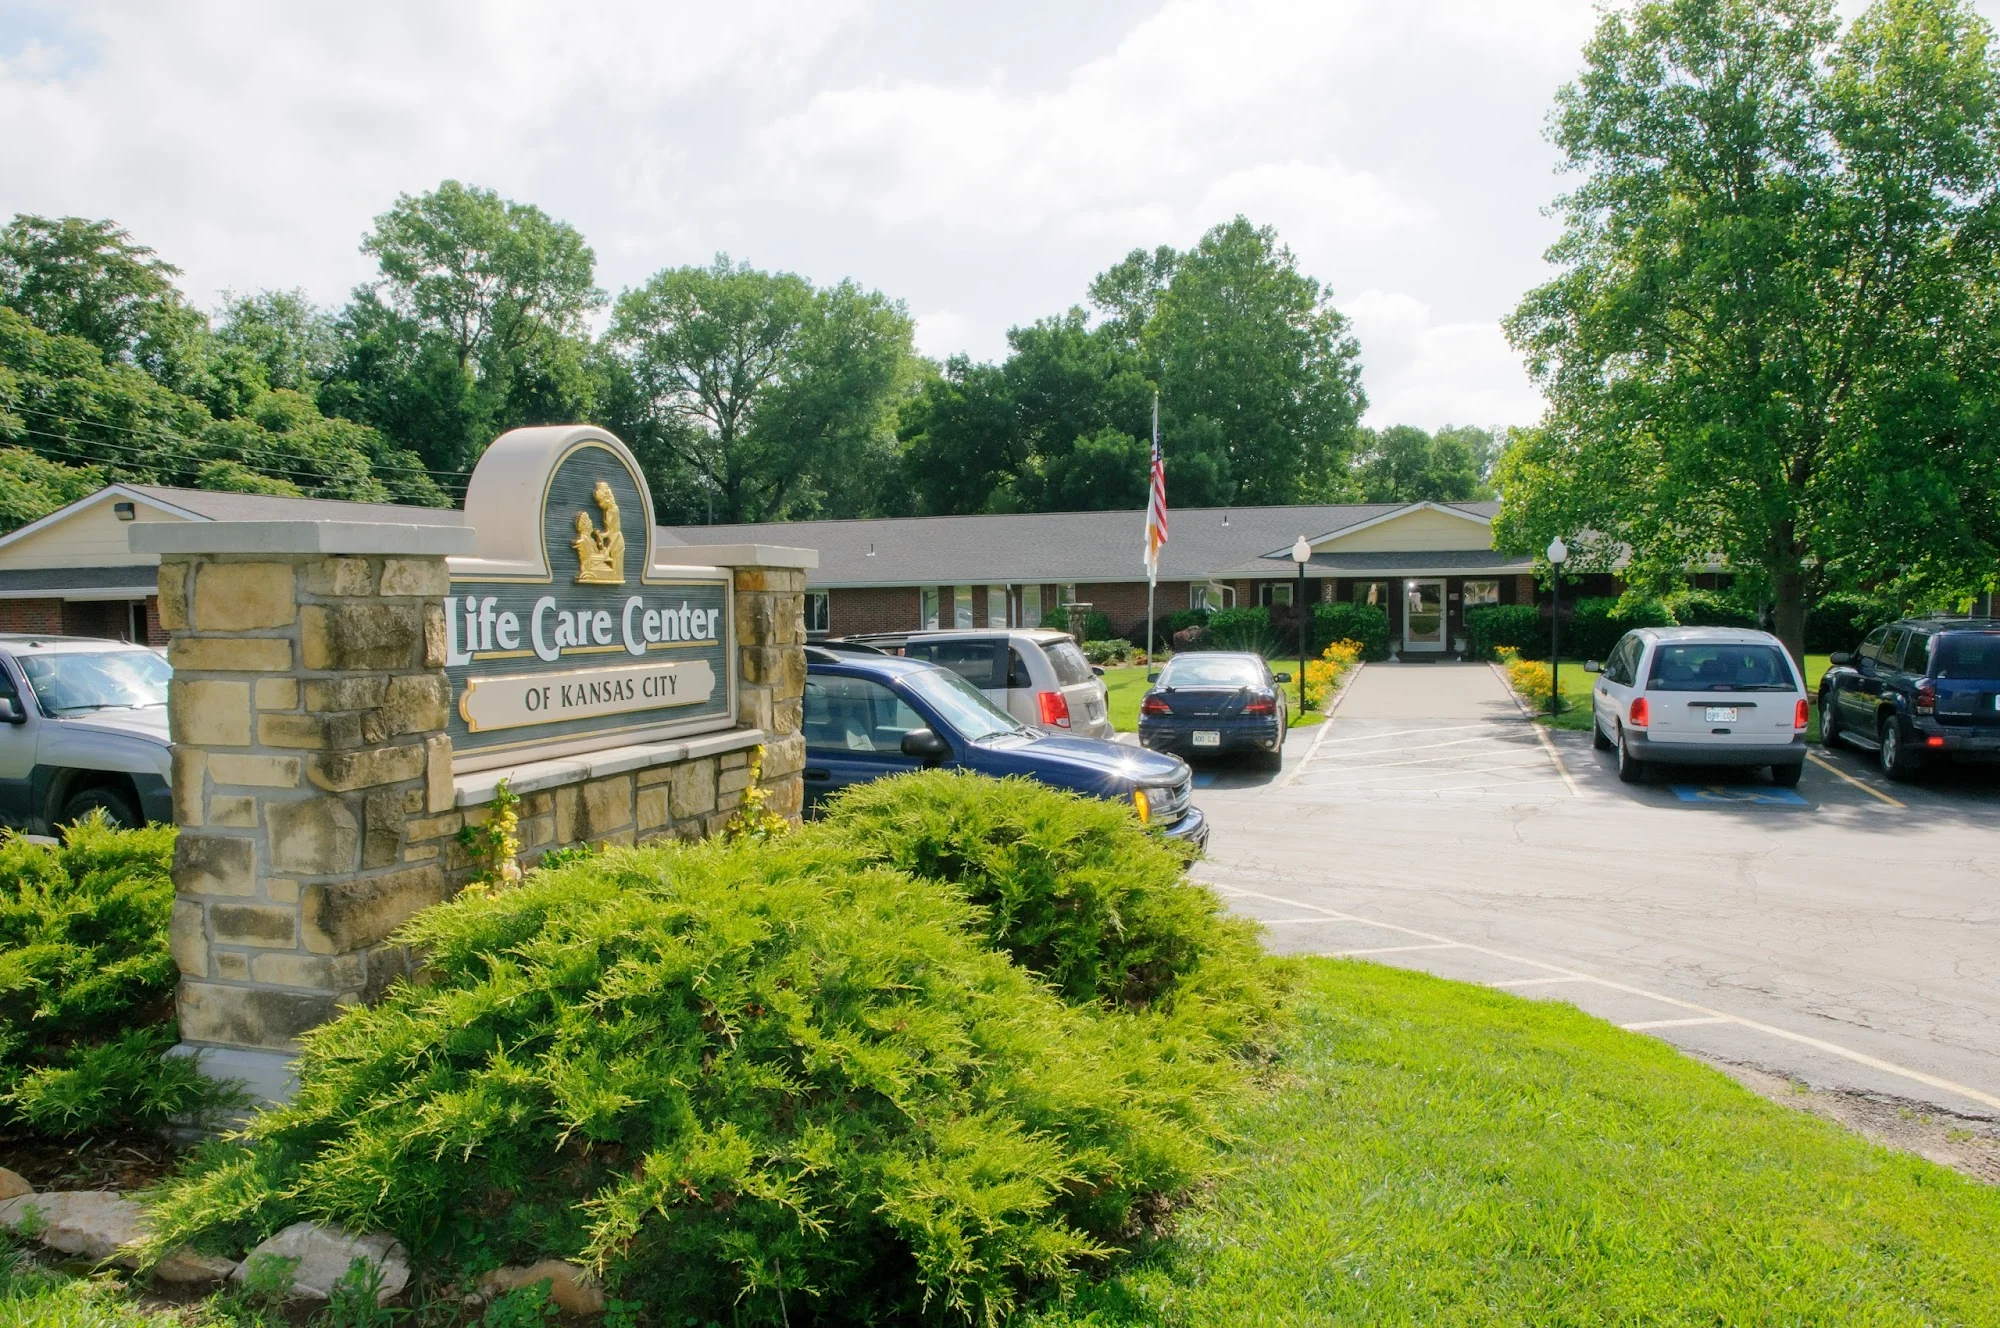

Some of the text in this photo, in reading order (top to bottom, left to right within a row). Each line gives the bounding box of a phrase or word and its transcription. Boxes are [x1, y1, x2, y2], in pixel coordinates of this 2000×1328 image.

[444, 596, 719, 667] Life Care Center
[525, 675, 677, 712] OF KANSAS CITY
